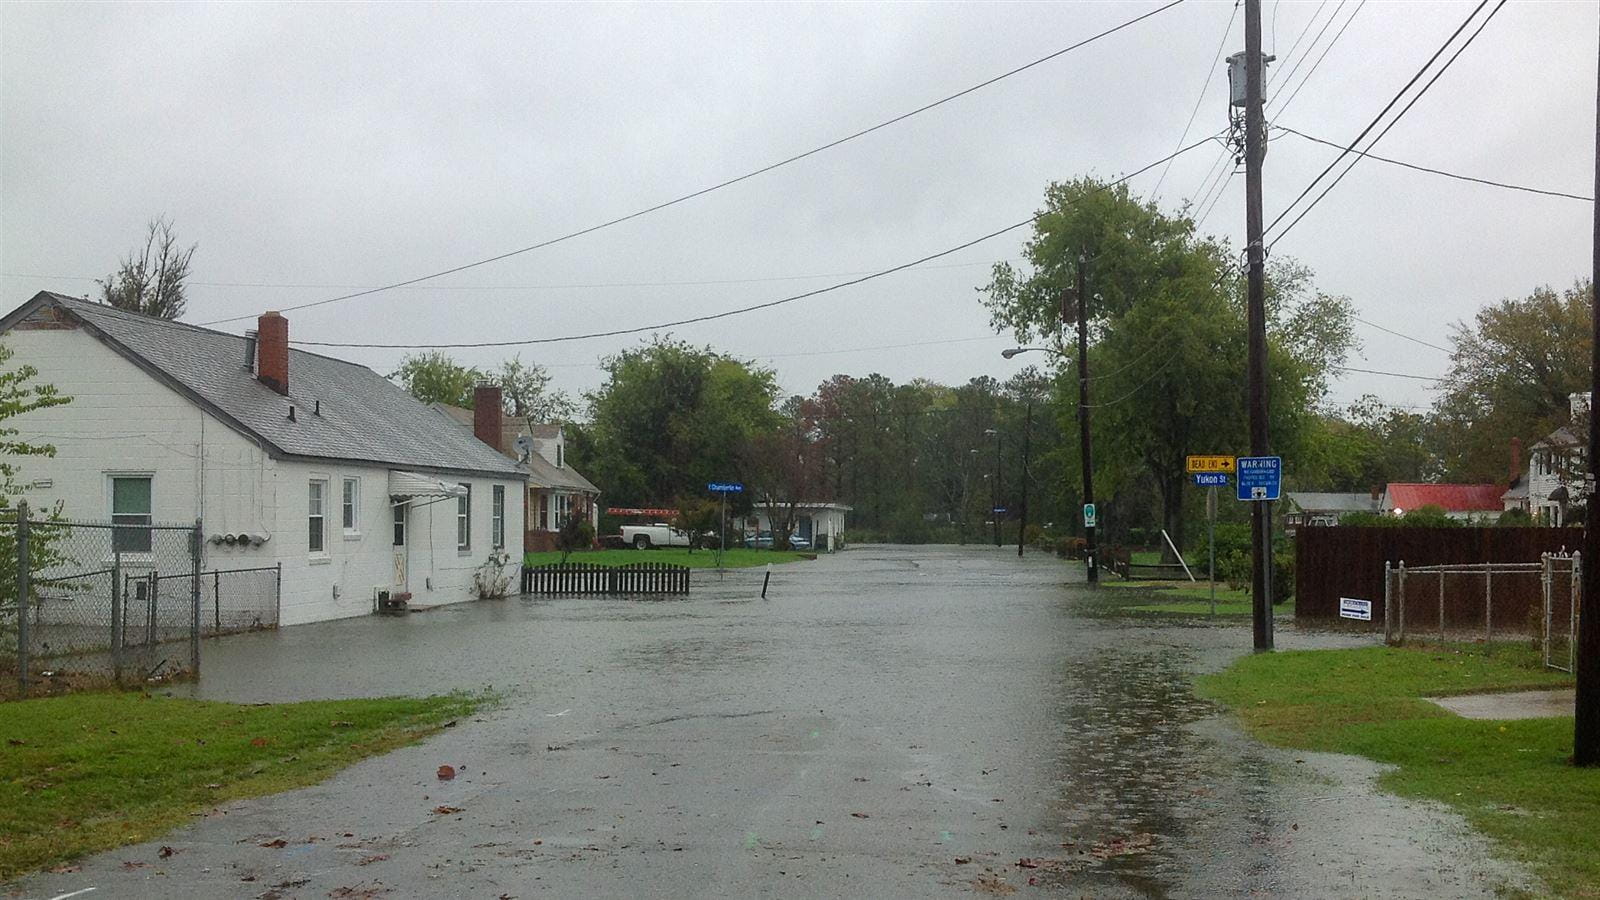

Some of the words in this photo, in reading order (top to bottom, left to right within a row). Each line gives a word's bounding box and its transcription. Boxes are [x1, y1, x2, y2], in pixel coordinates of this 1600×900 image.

[1192, 459, 1205, 469] DEAD
[1208, 459, 1217, 469] END
[1241, 459, 1277, 469] WARNING
[1196, 474, 1218, 484] Yukon
[1219, 474, 1226, 483] St
